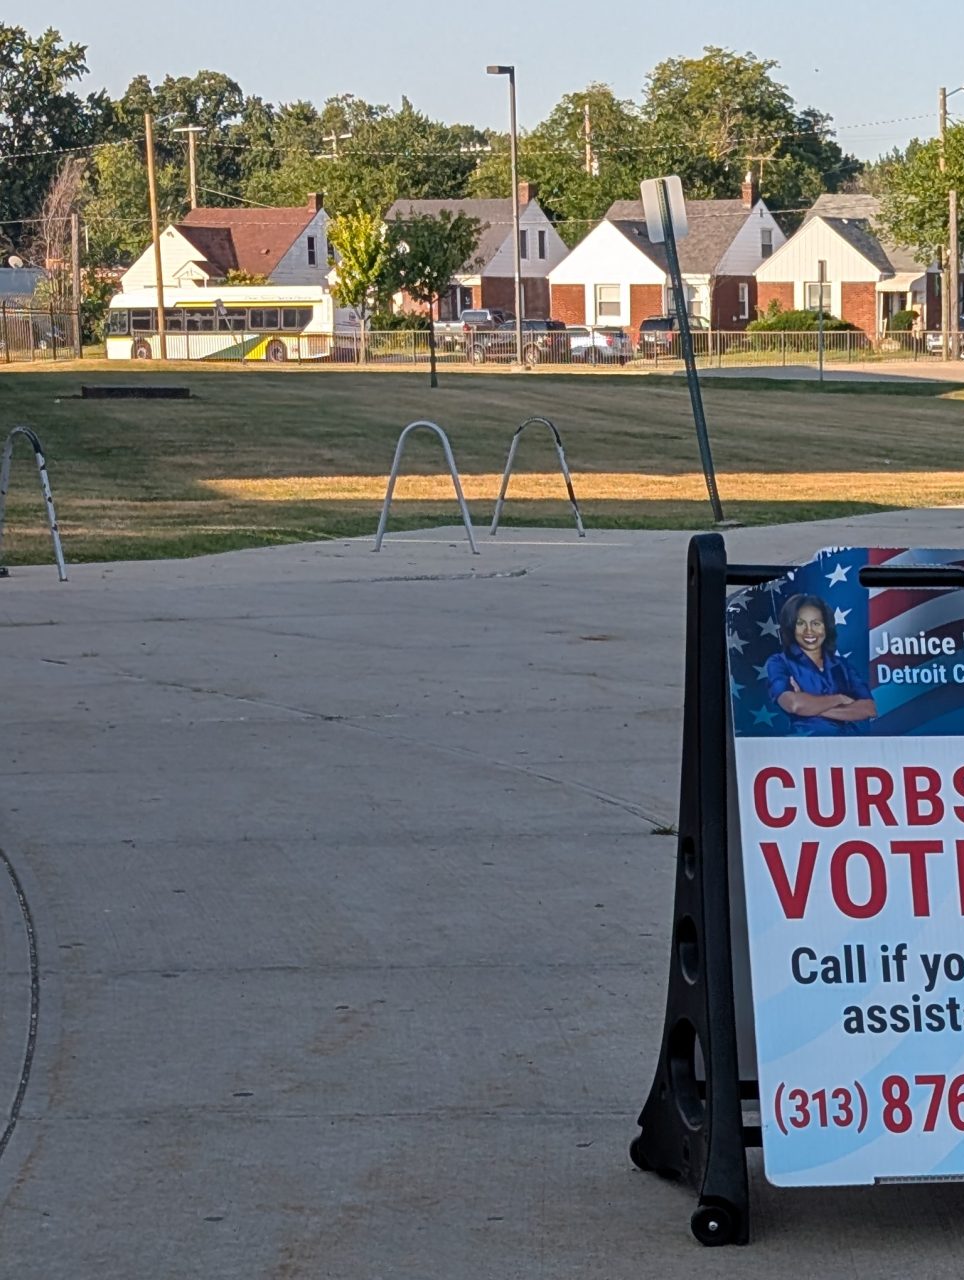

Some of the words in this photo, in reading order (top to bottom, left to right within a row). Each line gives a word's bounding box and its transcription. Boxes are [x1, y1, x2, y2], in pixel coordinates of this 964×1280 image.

[875, 631, 956, 655] Janice
[877, 663, 947, 684] Detroit
[791, 944, 866, 984] Call
[881, 943, 907, 982] if
[774, 1081, 868, 1136] (313)
